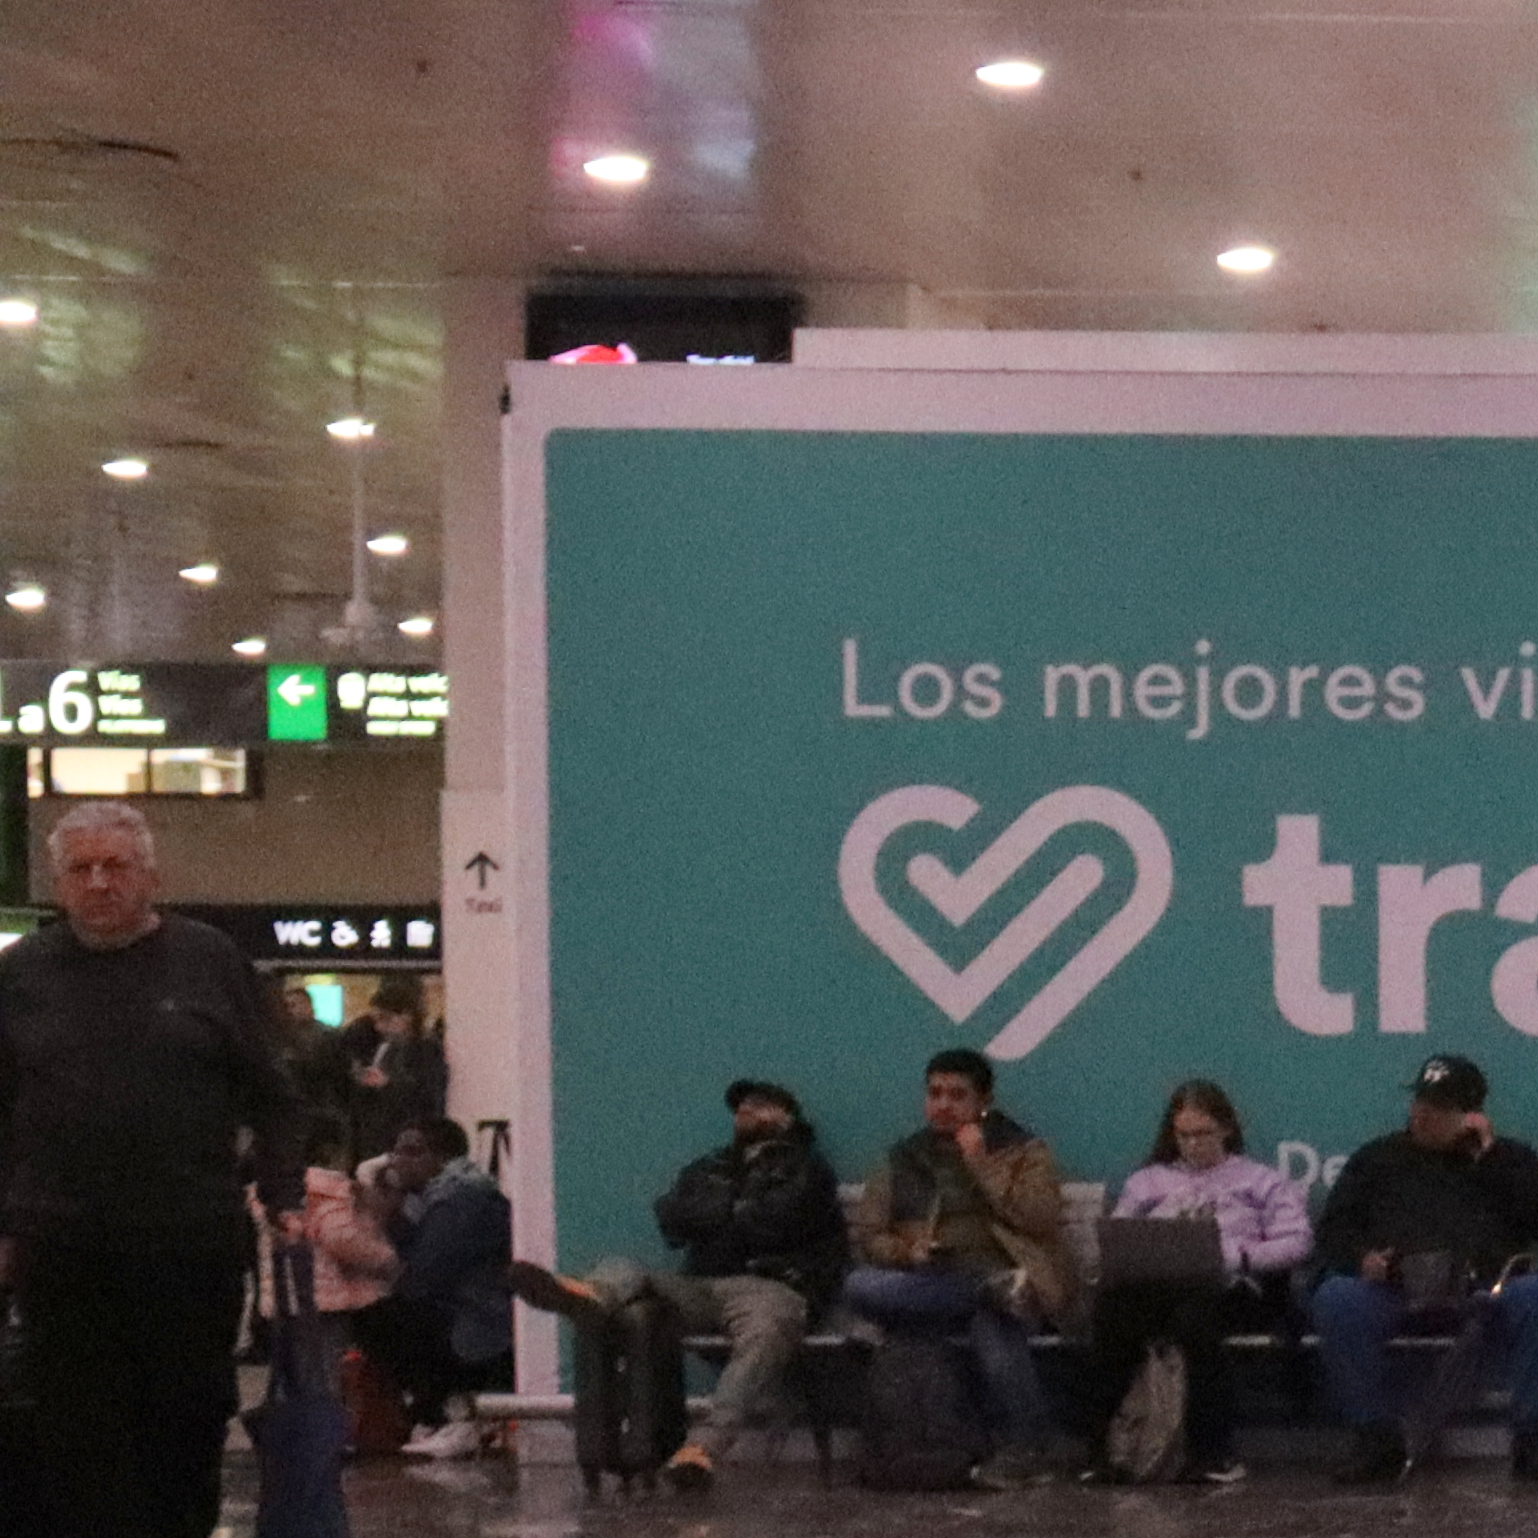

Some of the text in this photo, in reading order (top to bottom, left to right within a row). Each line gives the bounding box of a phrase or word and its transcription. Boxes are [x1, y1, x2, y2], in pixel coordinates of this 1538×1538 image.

[48, 669, 94, 735] 6
[842, 637, 1002, 720] Los
[1042, 638, 1426, 741] mejores
[273, 919, 323, 946] WC
